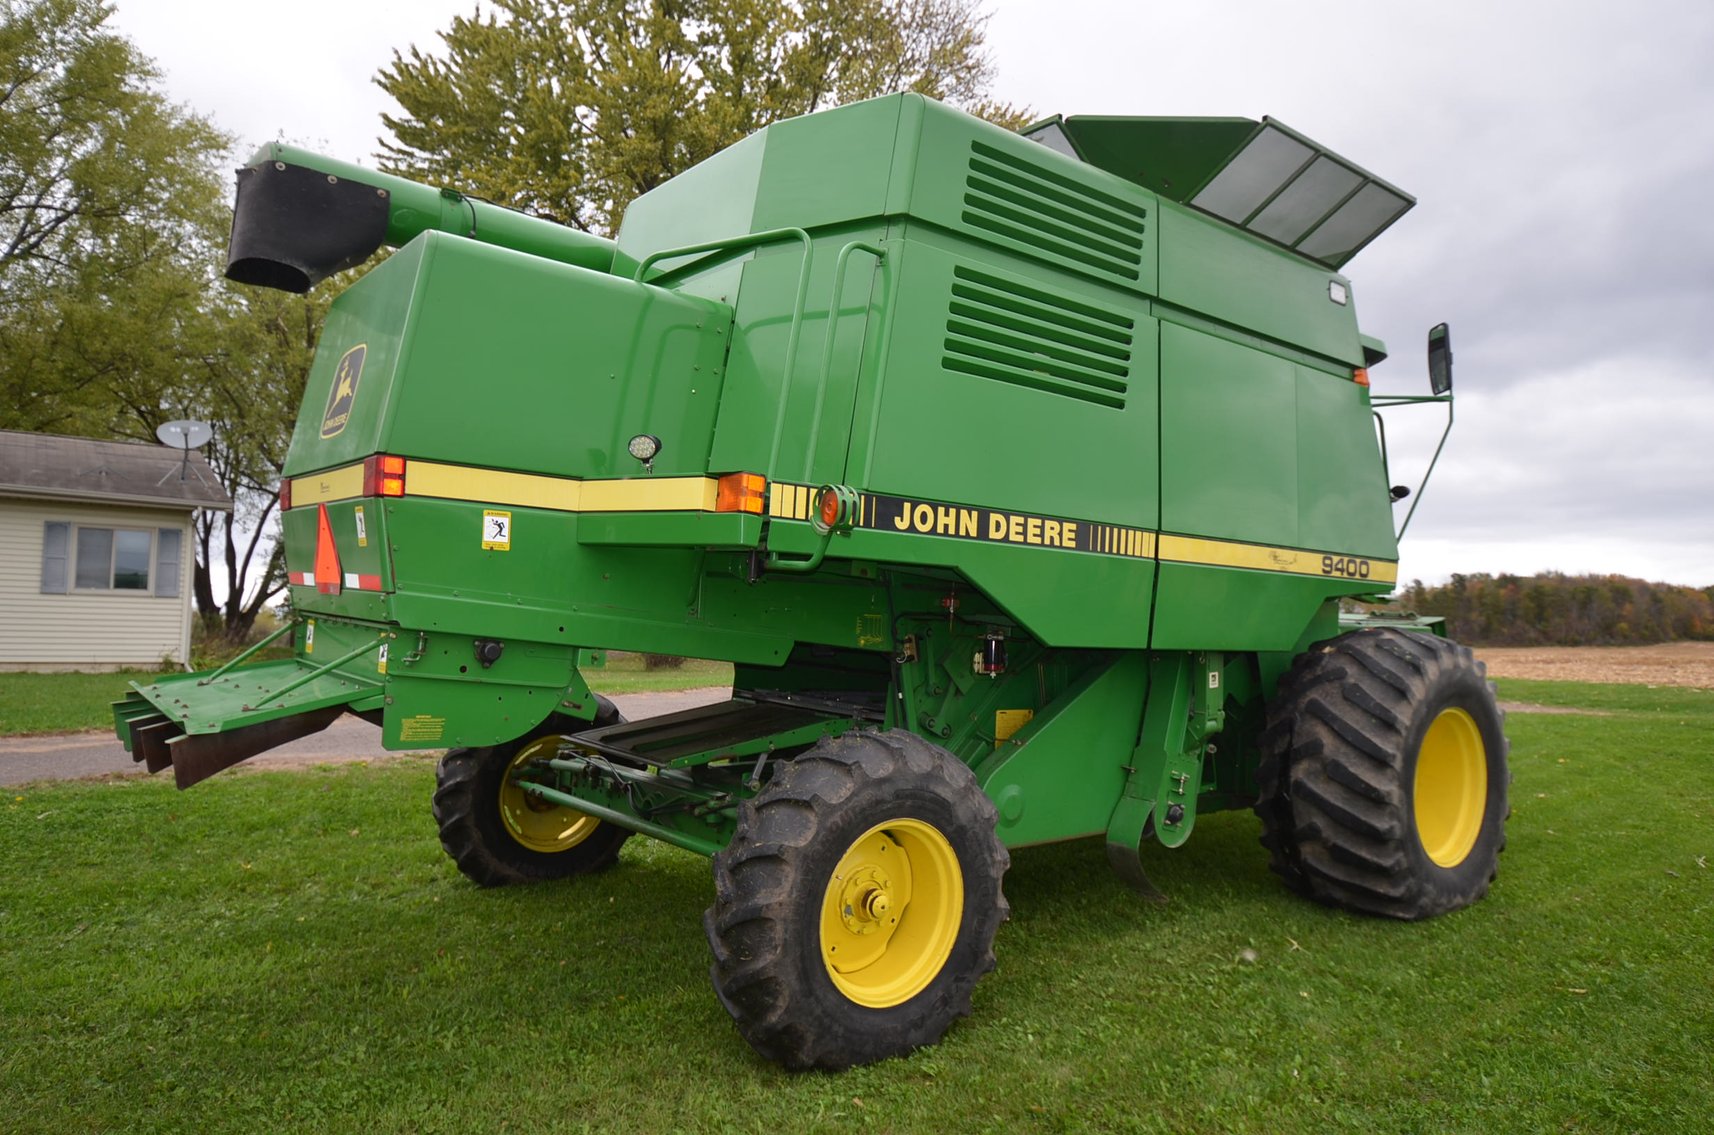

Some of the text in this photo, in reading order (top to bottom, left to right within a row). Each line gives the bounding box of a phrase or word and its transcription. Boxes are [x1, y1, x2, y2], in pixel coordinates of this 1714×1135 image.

[894, 502, 1077, 548] JOHN DEERE
[1322, 556, 1370, 578] 9400
